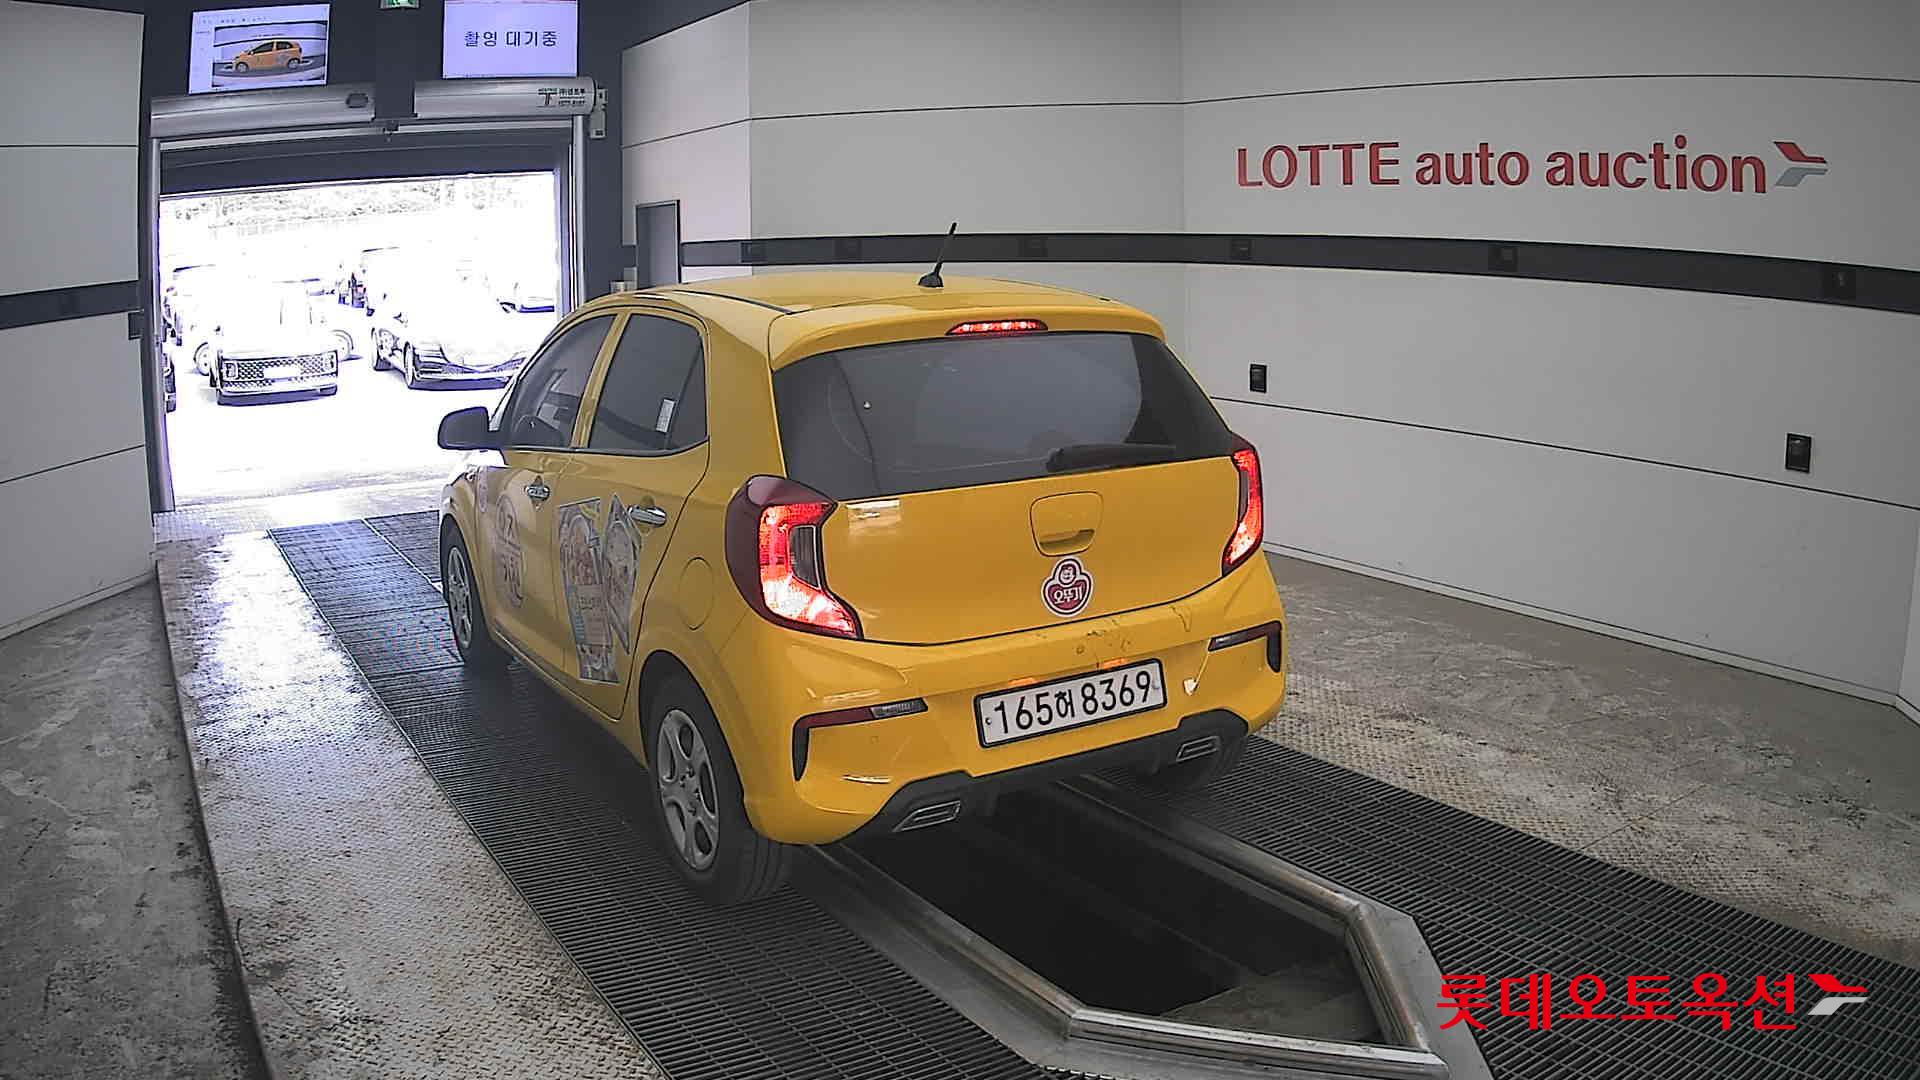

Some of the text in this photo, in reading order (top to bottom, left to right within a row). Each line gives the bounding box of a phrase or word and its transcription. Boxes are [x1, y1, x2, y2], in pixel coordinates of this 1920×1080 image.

[464, 30, 558, 47] 촬영 대기중
[1236, 134, 1767, 194] LOTTE auto auction
[1053, 584, 1083, 605] 오뚜기
[1080, 670, 1151, 716] 8369
